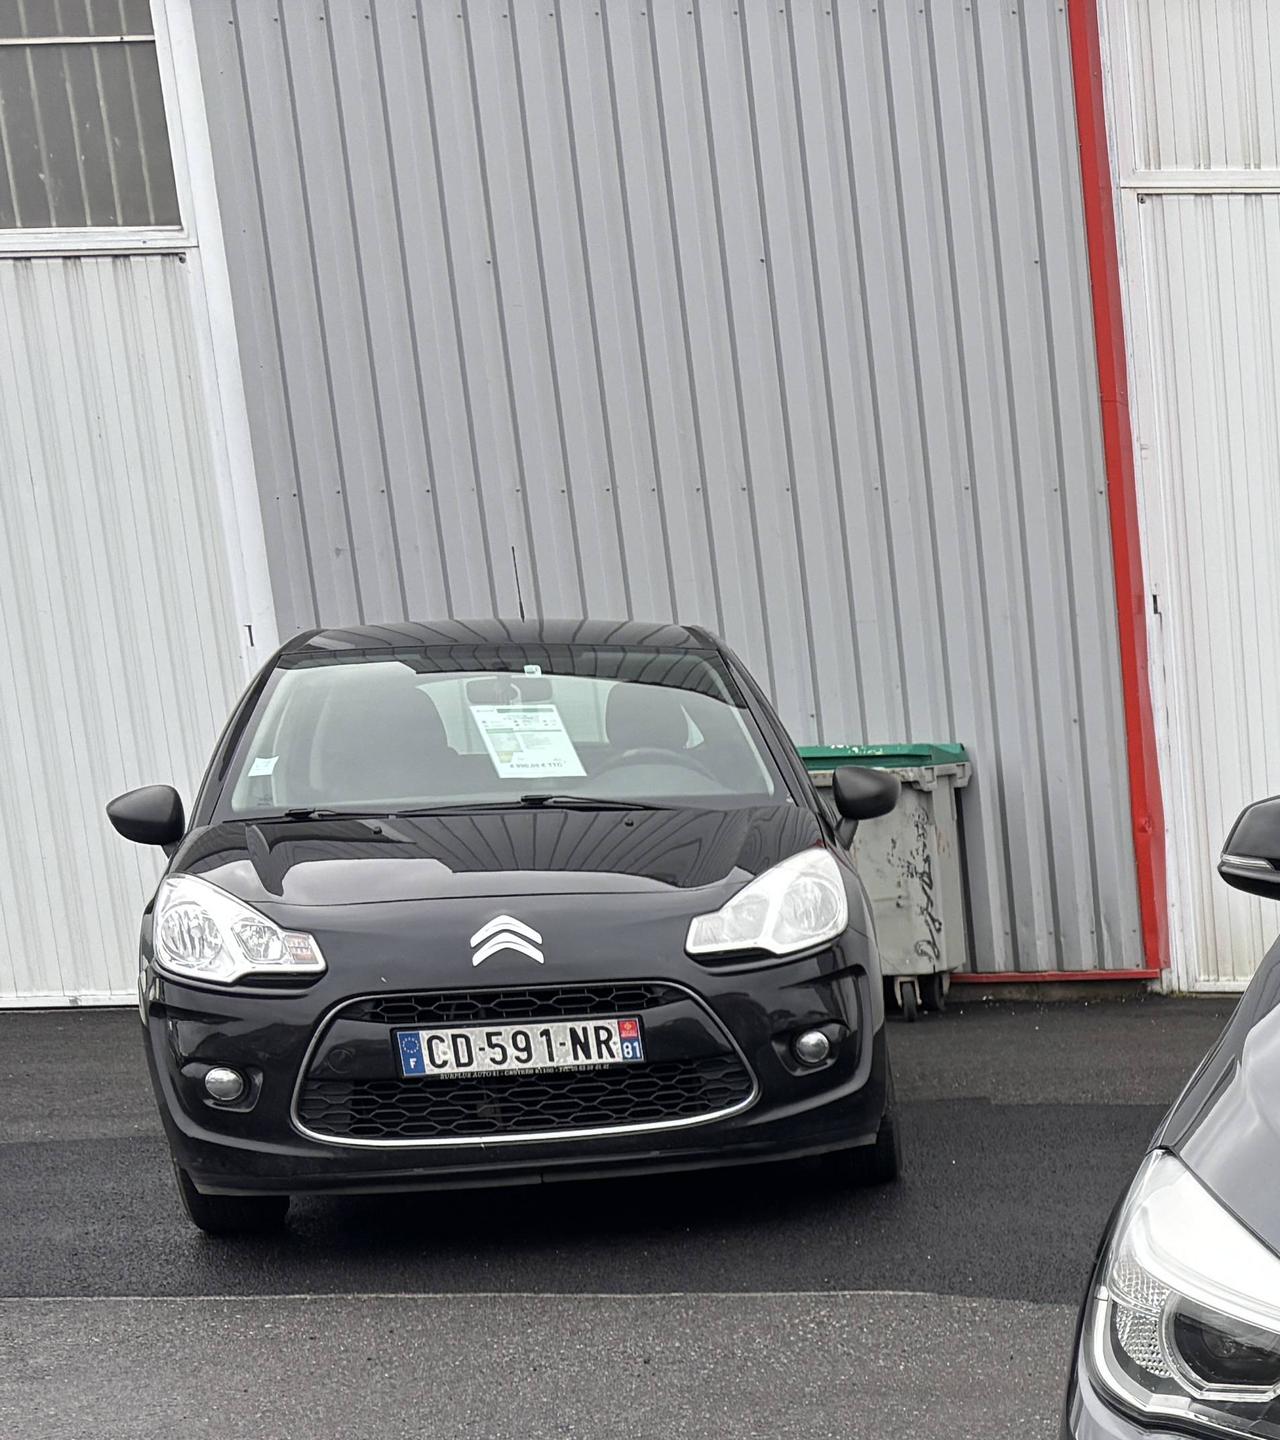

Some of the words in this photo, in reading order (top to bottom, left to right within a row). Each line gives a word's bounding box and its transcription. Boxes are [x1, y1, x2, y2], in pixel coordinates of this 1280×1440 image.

[427, 1026, 615, 1069] CD-591-NR
[623, 1042, 641, 1058] 81
[410, 1058, 417, 1069] F
